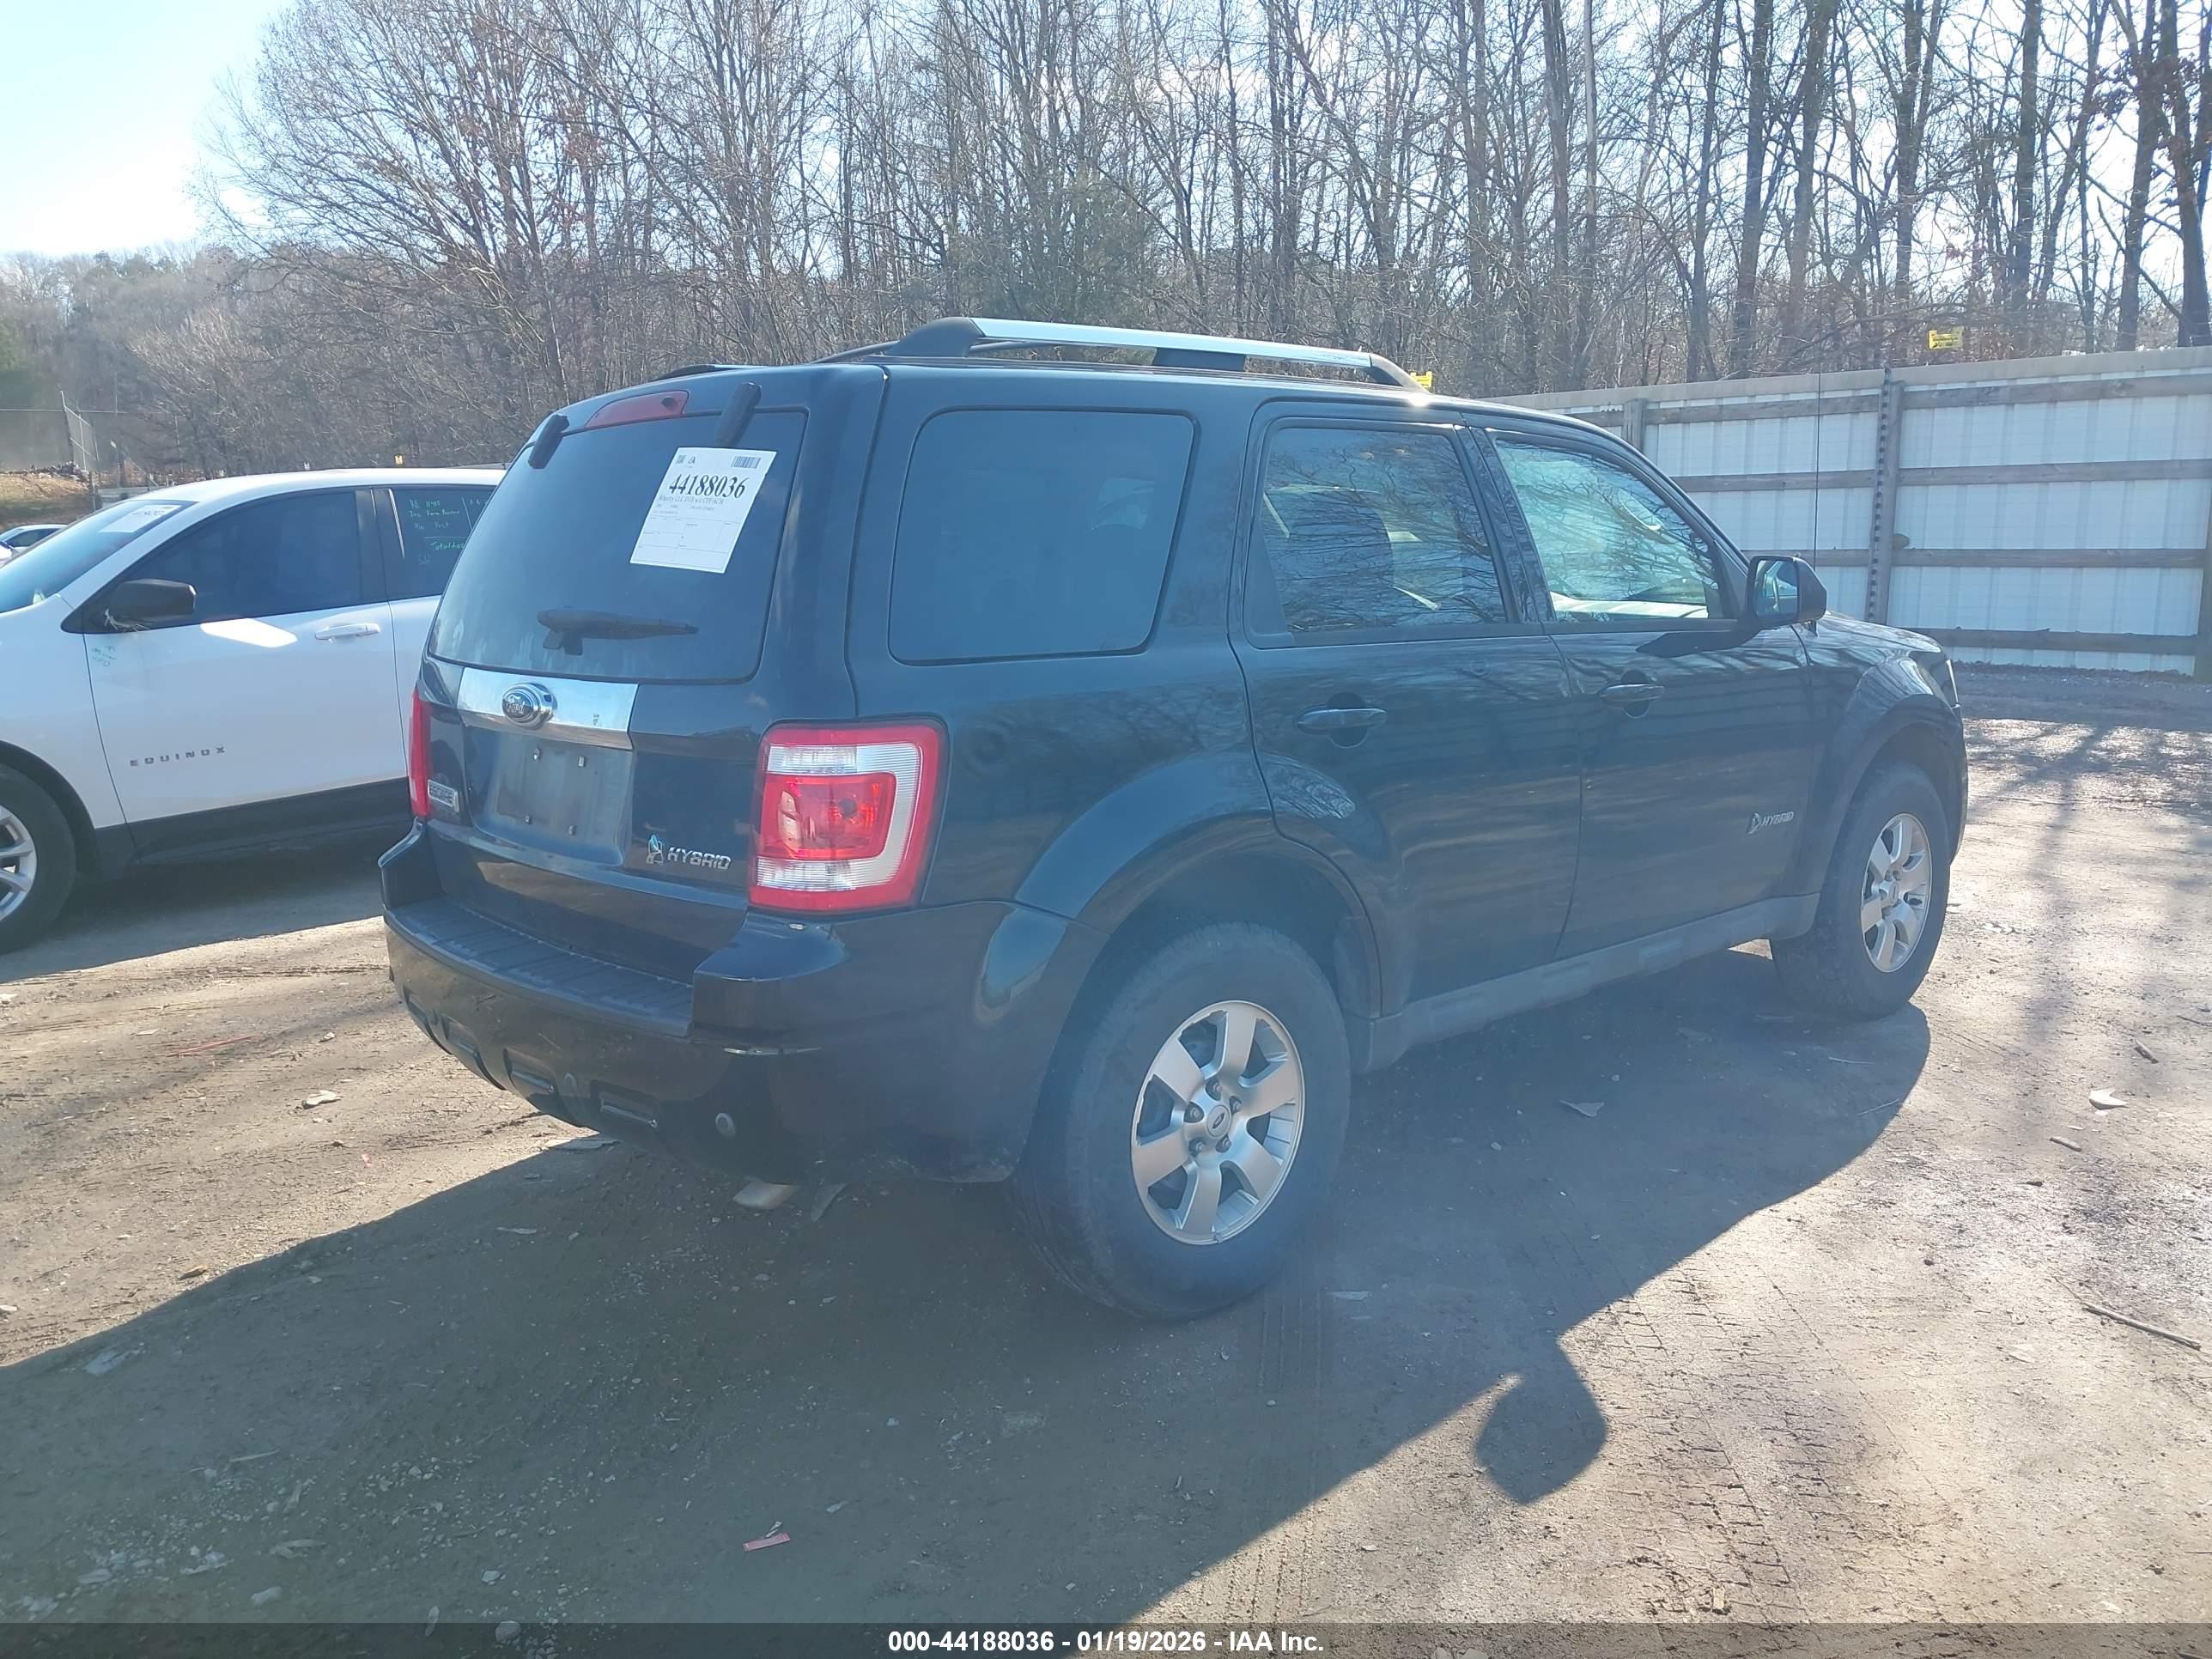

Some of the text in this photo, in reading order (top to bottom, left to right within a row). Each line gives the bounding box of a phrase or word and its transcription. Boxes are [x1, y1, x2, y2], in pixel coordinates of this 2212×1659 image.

[669, 473, 750, 499] 44188036
[130, 746, 225, 767] EQUINOX
[667, 847, 732, 870] HYBRID
